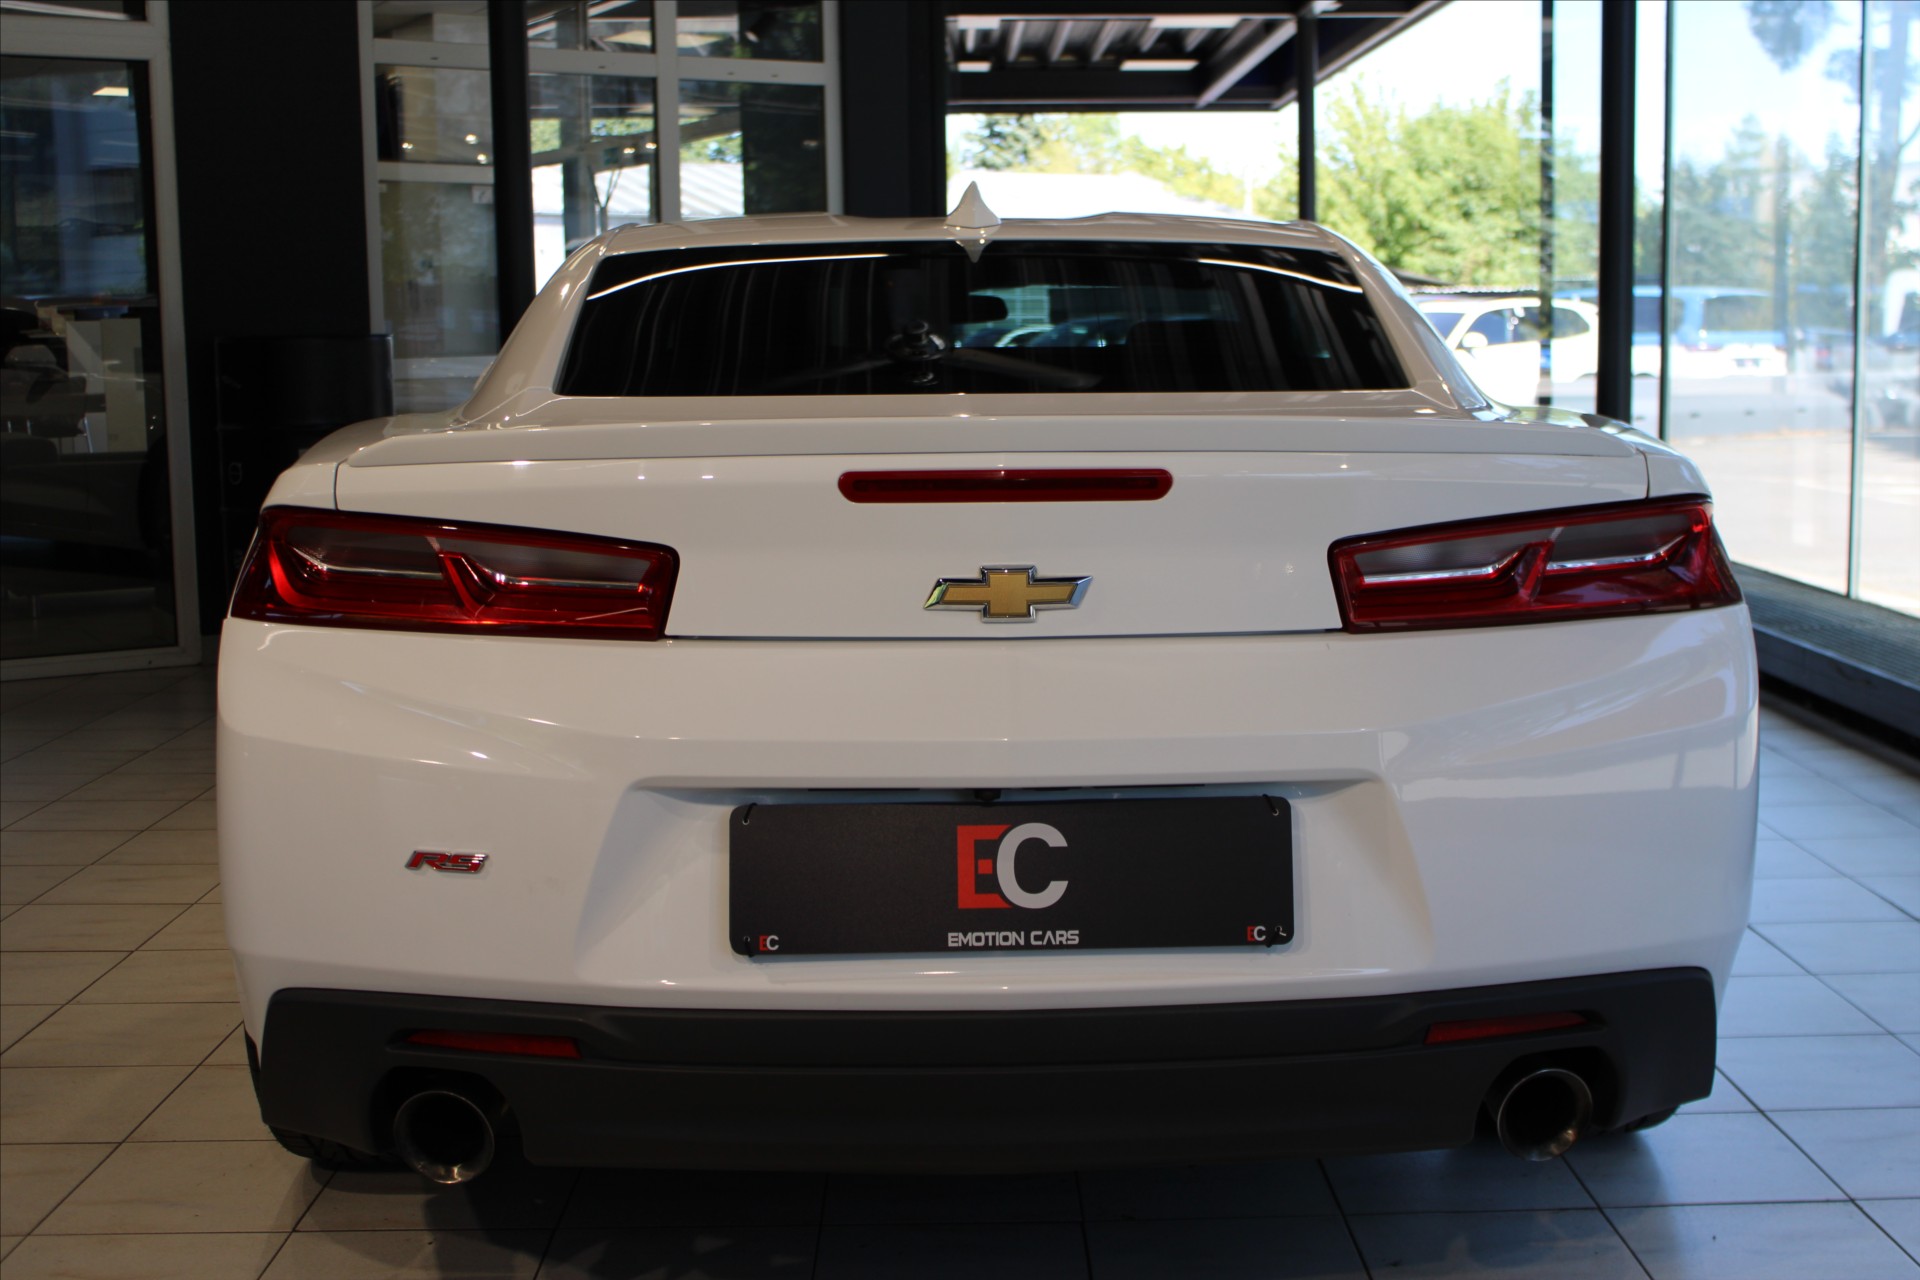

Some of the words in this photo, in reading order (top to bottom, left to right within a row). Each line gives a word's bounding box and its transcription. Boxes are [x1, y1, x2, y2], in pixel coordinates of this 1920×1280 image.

[405, 850, 489, 874] RS
[957, 822, 1069, 910] EC
[948, 931, 1025, 947] EMOTION
[1030, 930, 1080, 946] CARS
[1247, 925, 1266, 941] EC
[759, 935, 779, 951] EC
